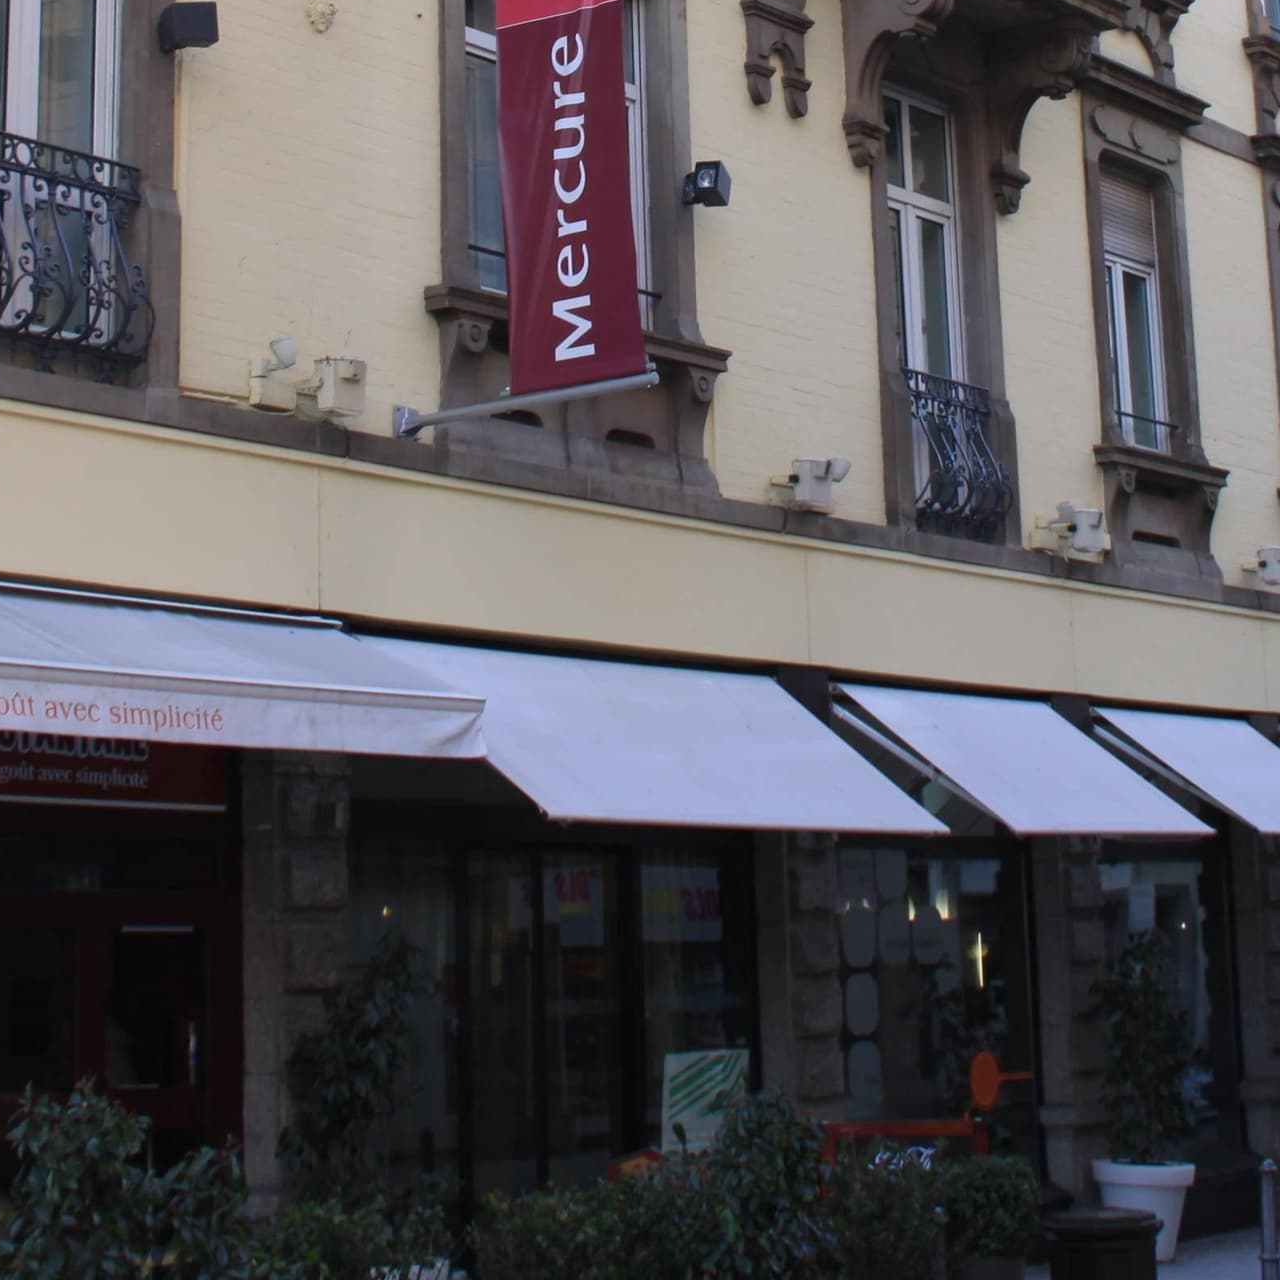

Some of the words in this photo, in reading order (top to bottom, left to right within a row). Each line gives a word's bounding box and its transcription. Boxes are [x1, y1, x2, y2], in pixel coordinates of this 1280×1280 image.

[551, 31, 597, 363] Mercure
[45, 700, 100, 723] avec
[109, 700, 224, 733] simplicité
[0, 762, 34, 784] goût
[37, 767, 73, 782] avec
[75, 765, 149, 790] simplicité
